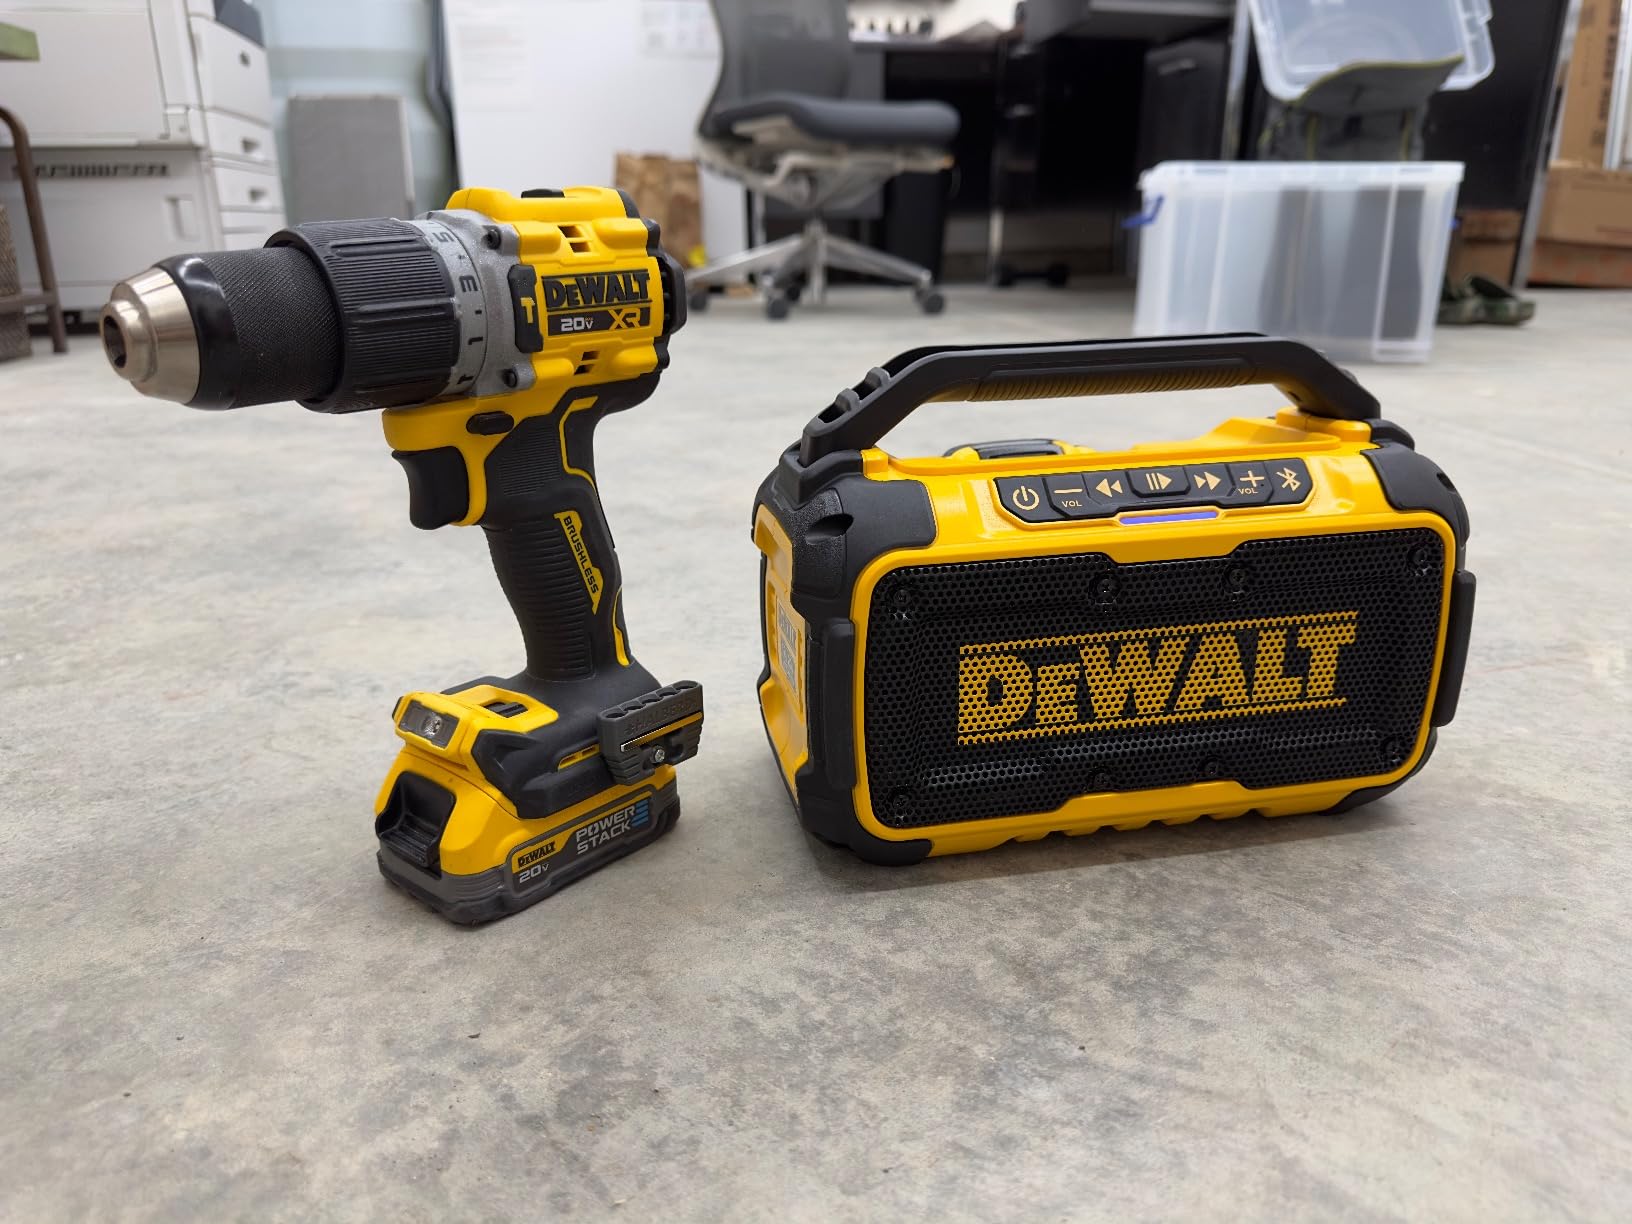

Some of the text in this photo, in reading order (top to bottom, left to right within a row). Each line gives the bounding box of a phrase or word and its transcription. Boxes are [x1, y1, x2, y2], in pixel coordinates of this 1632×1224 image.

[543, 273, 650, 308] DEWALT
[608, 308, 641, 330] XR
[1062, 500, 1083, 509] VOL
[1238, 487, 1258, 496] VOL
[563, 515, 598, 594] BRUSHLESS
[957, 621, 1357, 734] DEWALT
[576, 805, 636, 843] POWER
[576, 820, 632, 855] STACK
